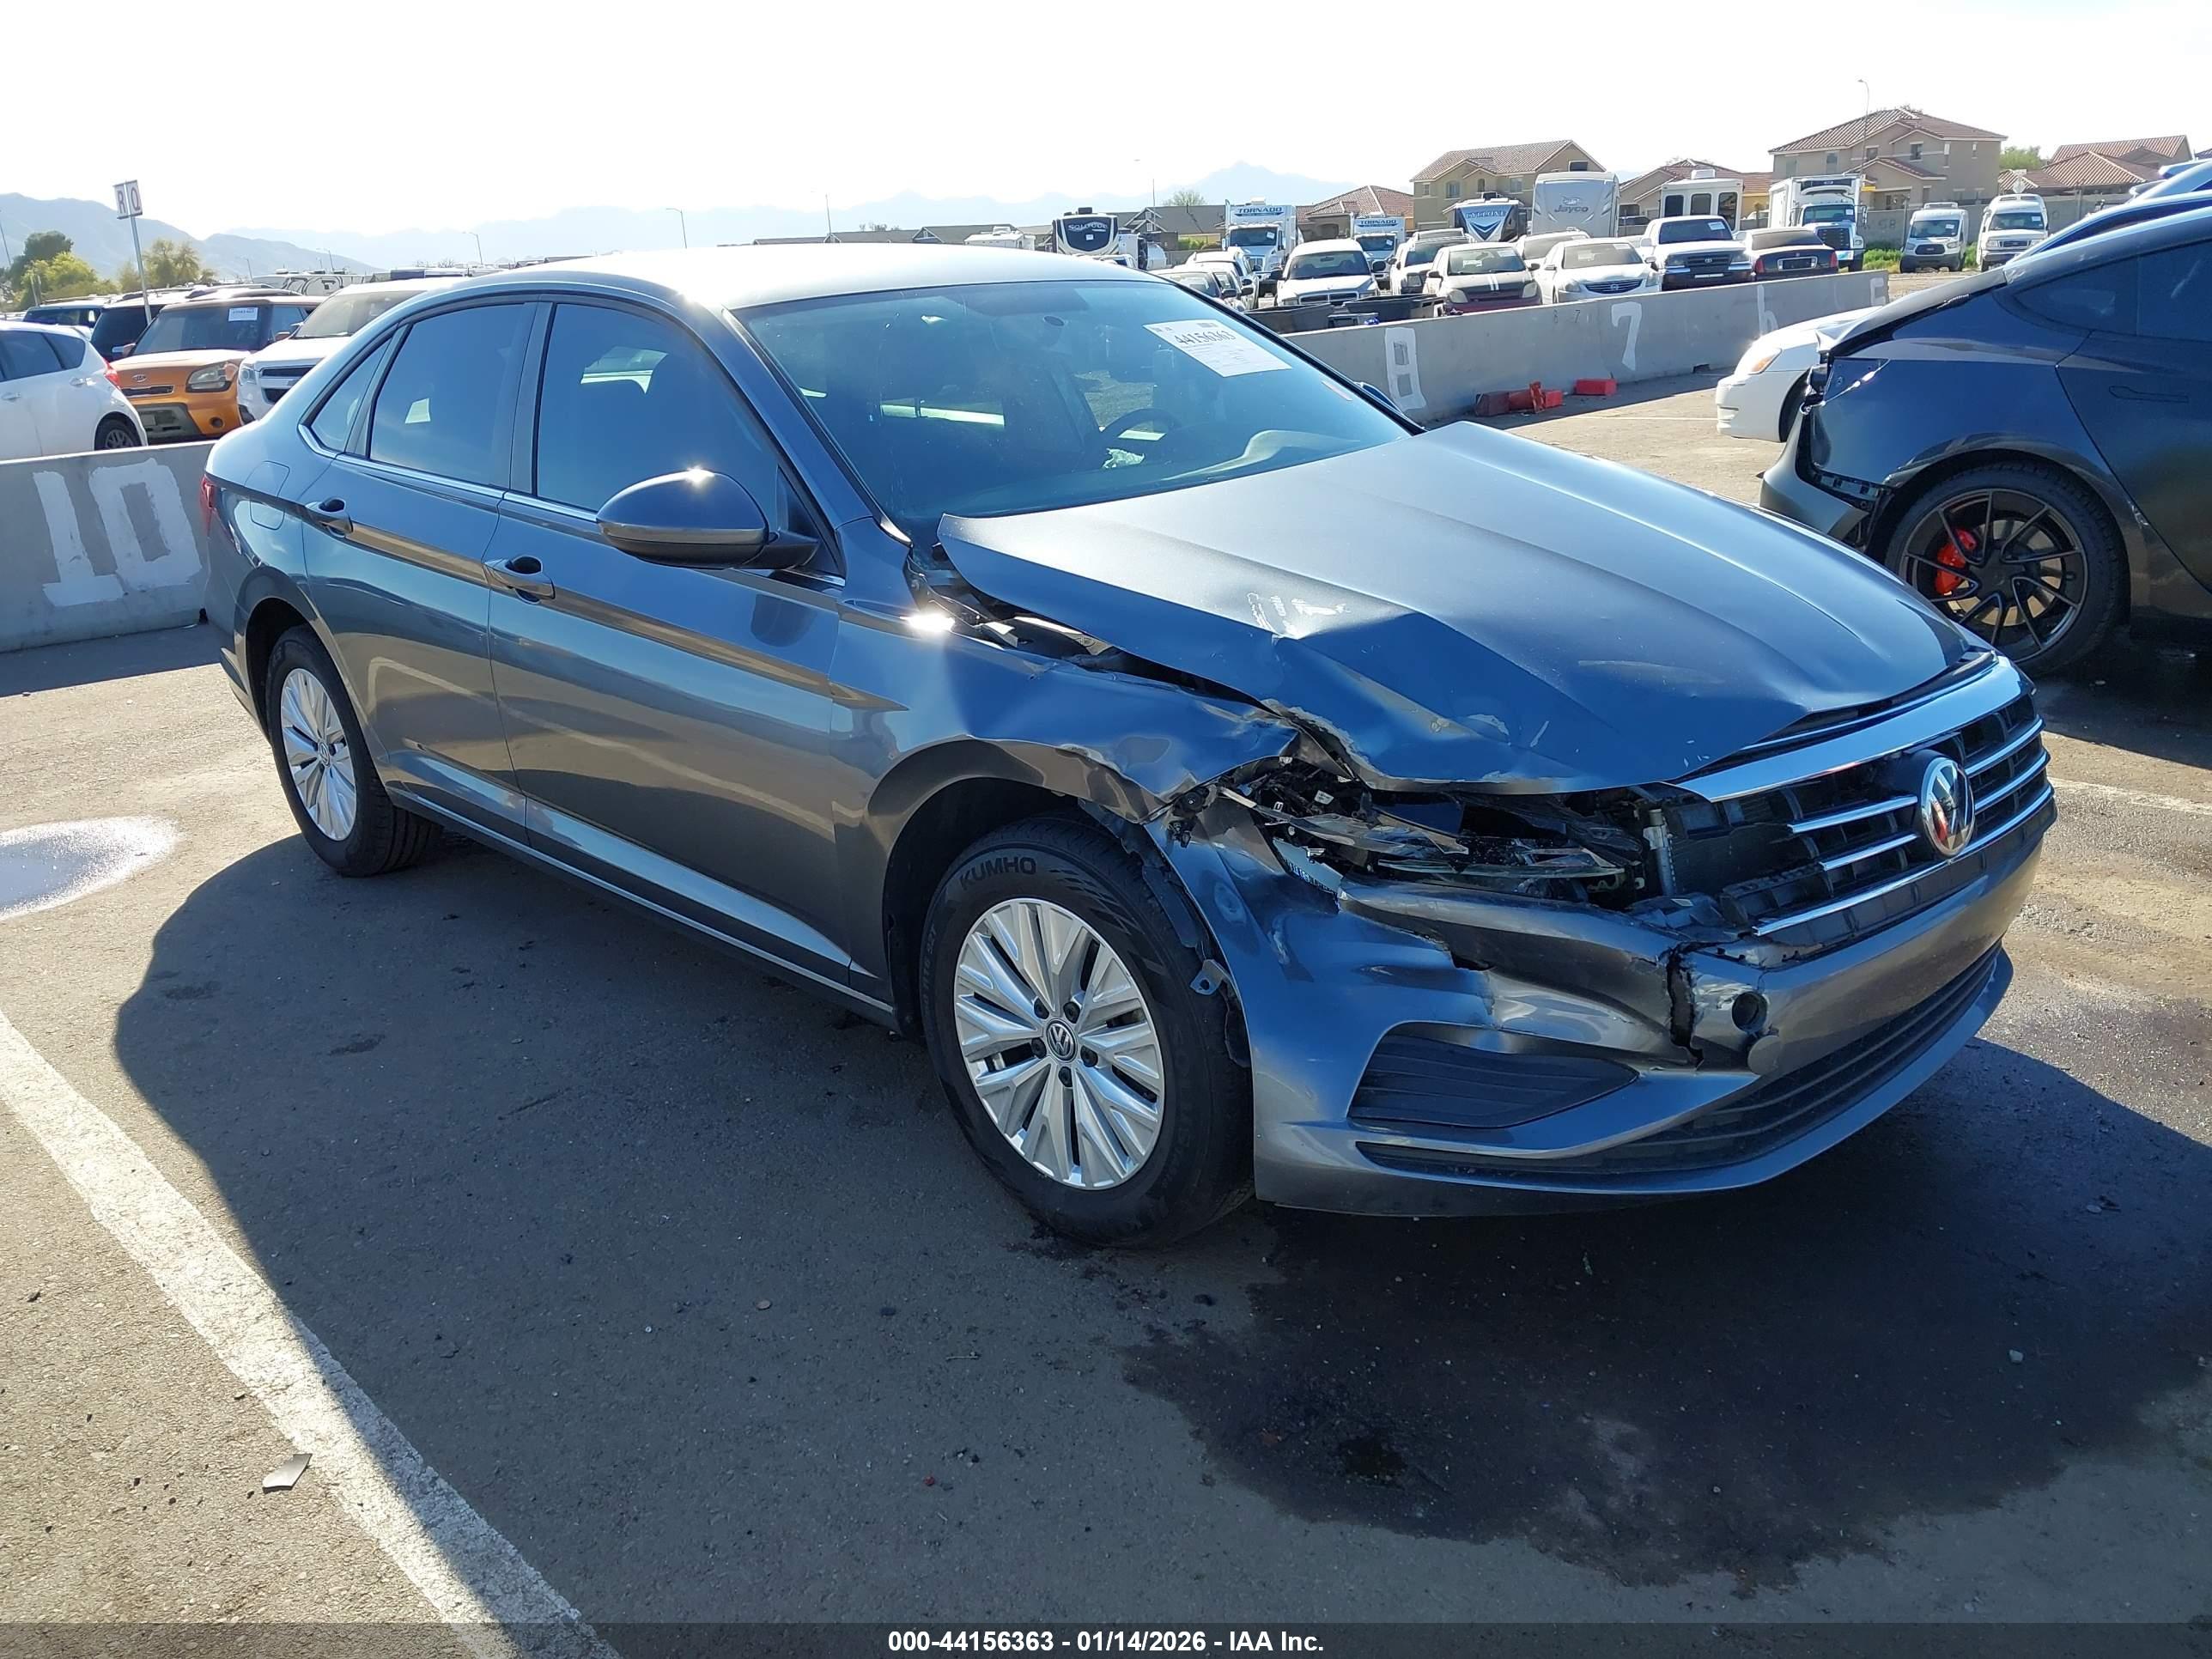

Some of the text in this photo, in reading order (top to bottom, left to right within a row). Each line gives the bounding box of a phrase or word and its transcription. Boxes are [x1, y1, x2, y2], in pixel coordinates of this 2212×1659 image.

[117, 190, 126, 214] R
[1553, 205, 1589, 214] Jayco
[1174, 330, 1237, 345] 44156363
[1611, 301, 1643, 371] 7
[1385, 327, 1426, 410] 8
[33, 458, 202, 606] 10
[959, 856, 1037, 891] KUMHO
